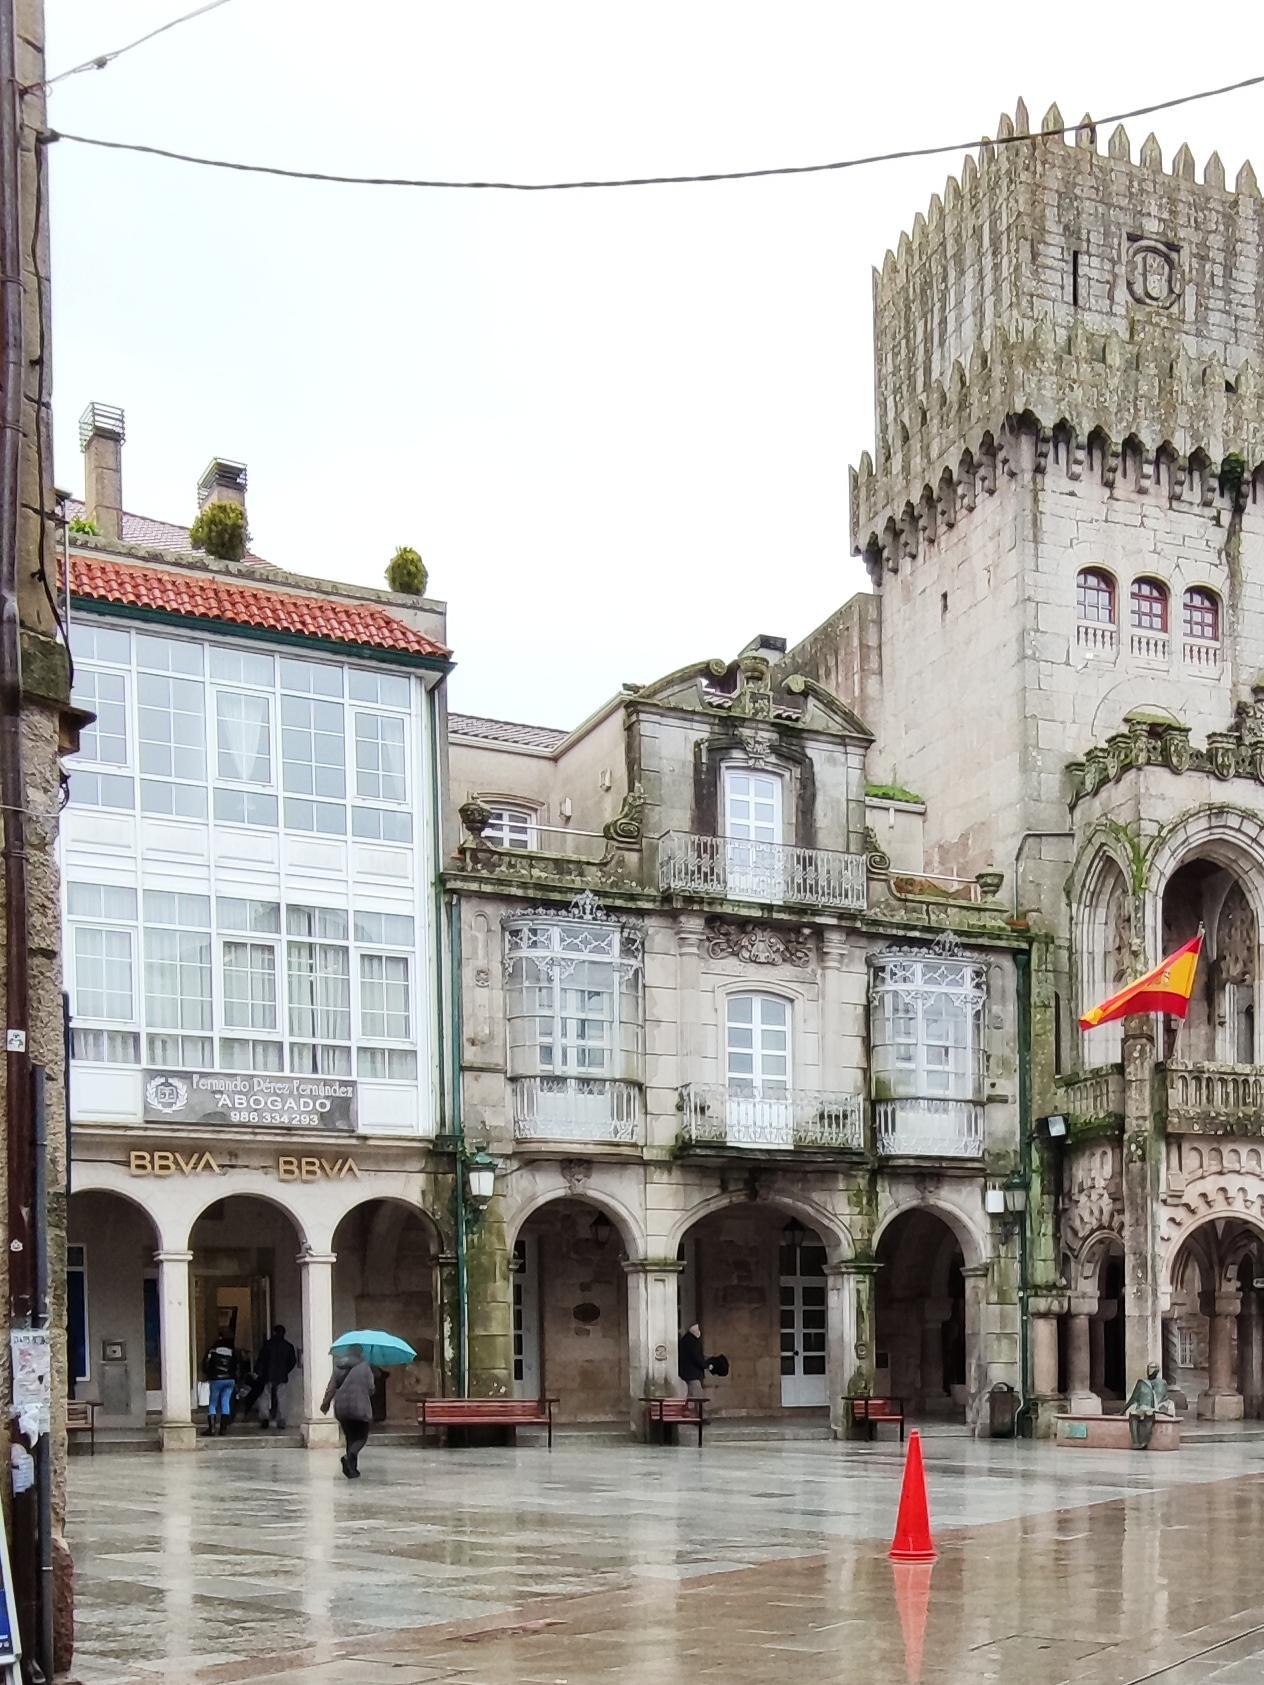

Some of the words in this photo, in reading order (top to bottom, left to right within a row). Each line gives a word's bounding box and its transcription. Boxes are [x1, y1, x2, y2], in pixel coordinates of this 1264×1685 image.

[192, 1074, 249, 1092] Fernando
[253, 1077, 289, 1094] Pérez
[293, 1079, 353, 1098] Fernández
[217, 1094, 332, 1112] ABOGADO
[230, 1111, 259, 1123] 986
[262, 1112, 289, 1124] 334
[292, 1113, 319, 1126] 293
[129, 1150, 222, 1177] BBVA
[278, 1156, 360, 1183] BBVA
